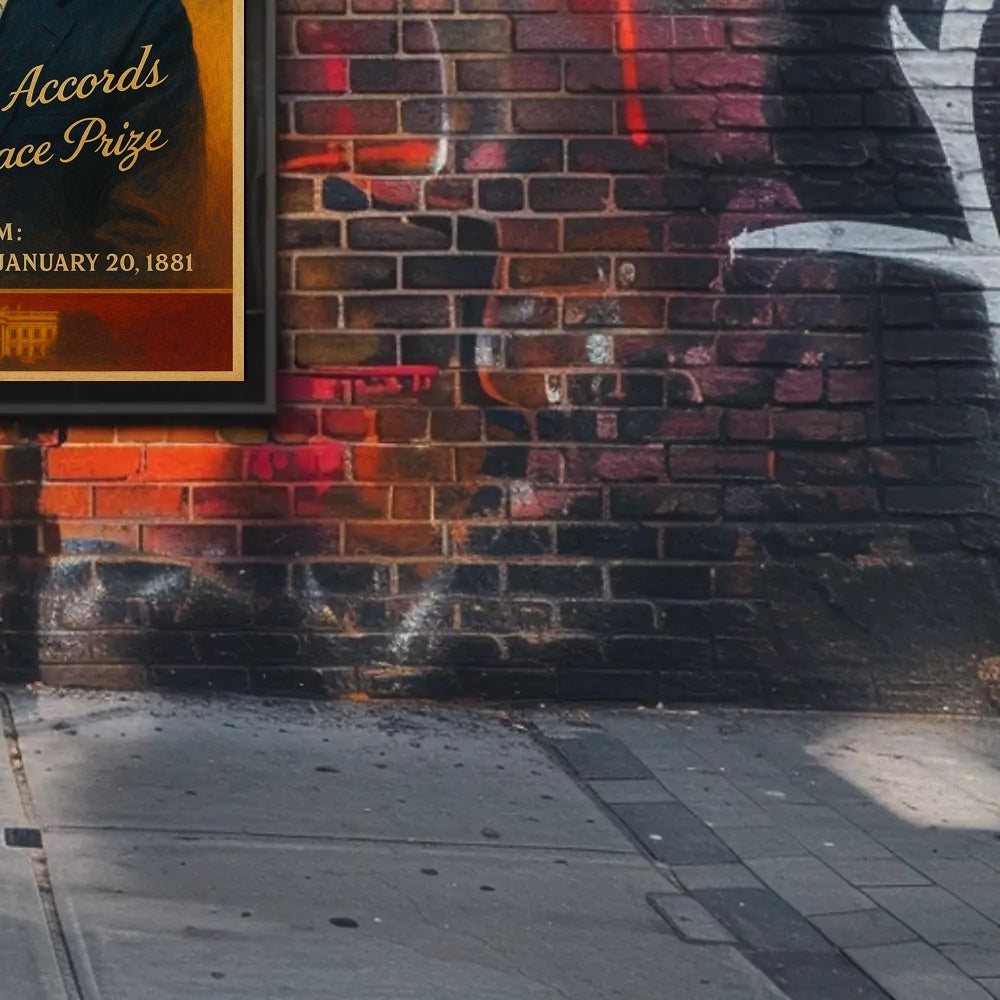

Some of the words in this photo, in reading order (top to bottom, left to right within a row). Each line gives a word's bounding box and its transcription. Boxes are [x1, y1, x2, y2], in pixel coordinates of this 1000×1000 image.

[1, 44, 169, 112] Accords
[60, 117, 169, 172] Prize
[106, 253, 140, 275] 20,
[146, 253, 194, 272] 1881
